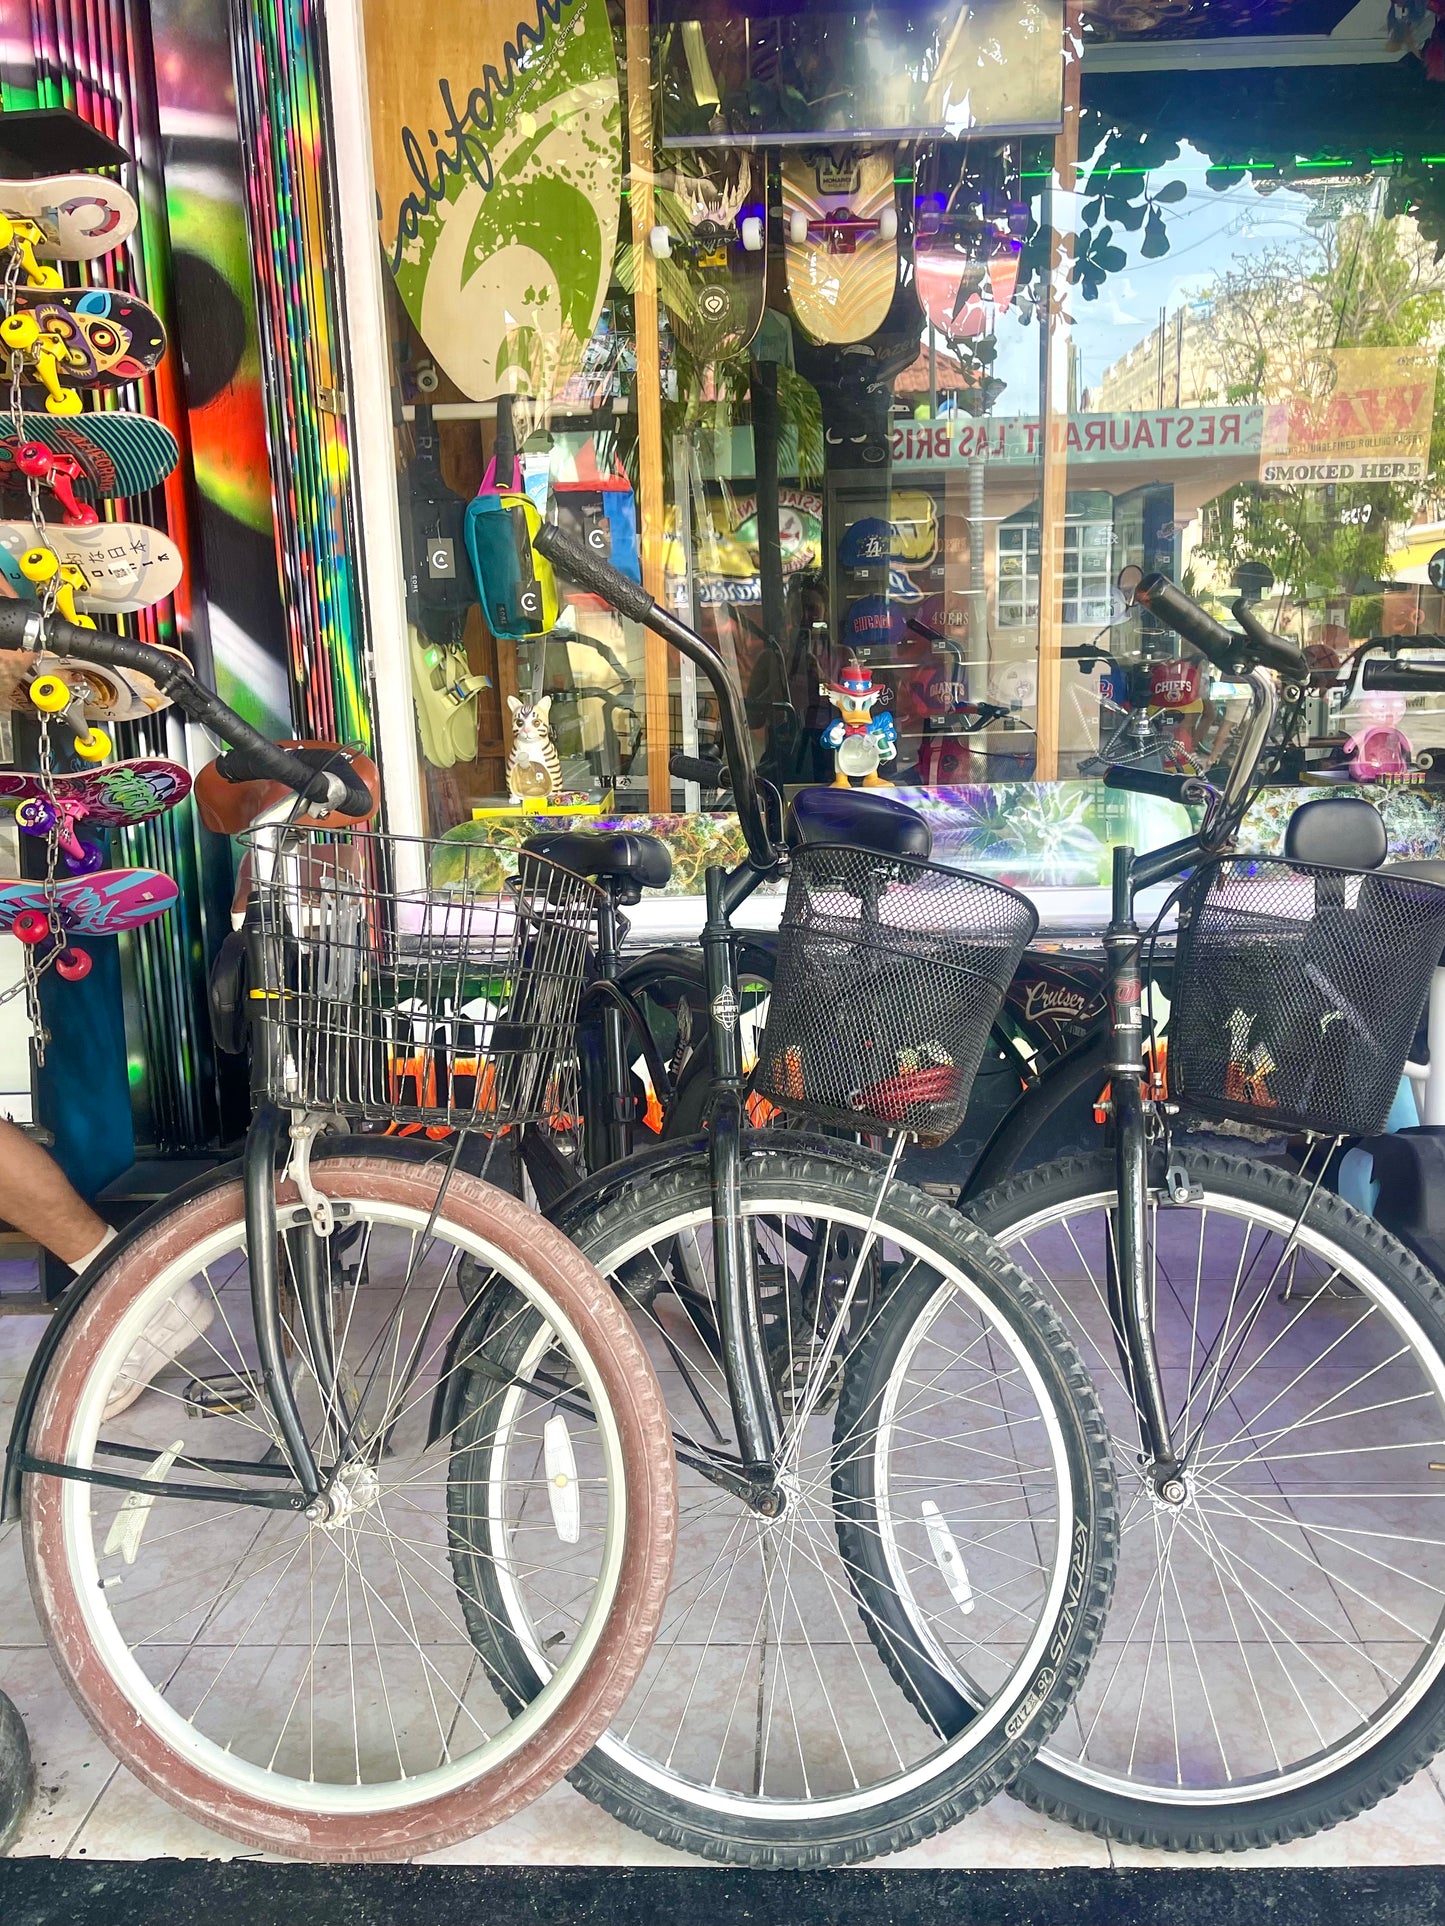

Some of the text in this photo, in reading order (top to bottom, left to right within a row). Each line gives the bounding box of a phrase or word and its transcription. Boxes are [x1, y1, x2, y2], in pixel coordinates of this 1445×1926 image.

[1264, 462, 1422, 482] SMOKED HERE
[931, 611, 969, 626] 49ERS
[1154, 680, 1193, 694] CHIEFS
[1025, 981, 1085, 1020] Cruiser
[1050, 1516, 1088, 1667] KRONOS
[1006, 1705, 1031, 1737] 2.125
